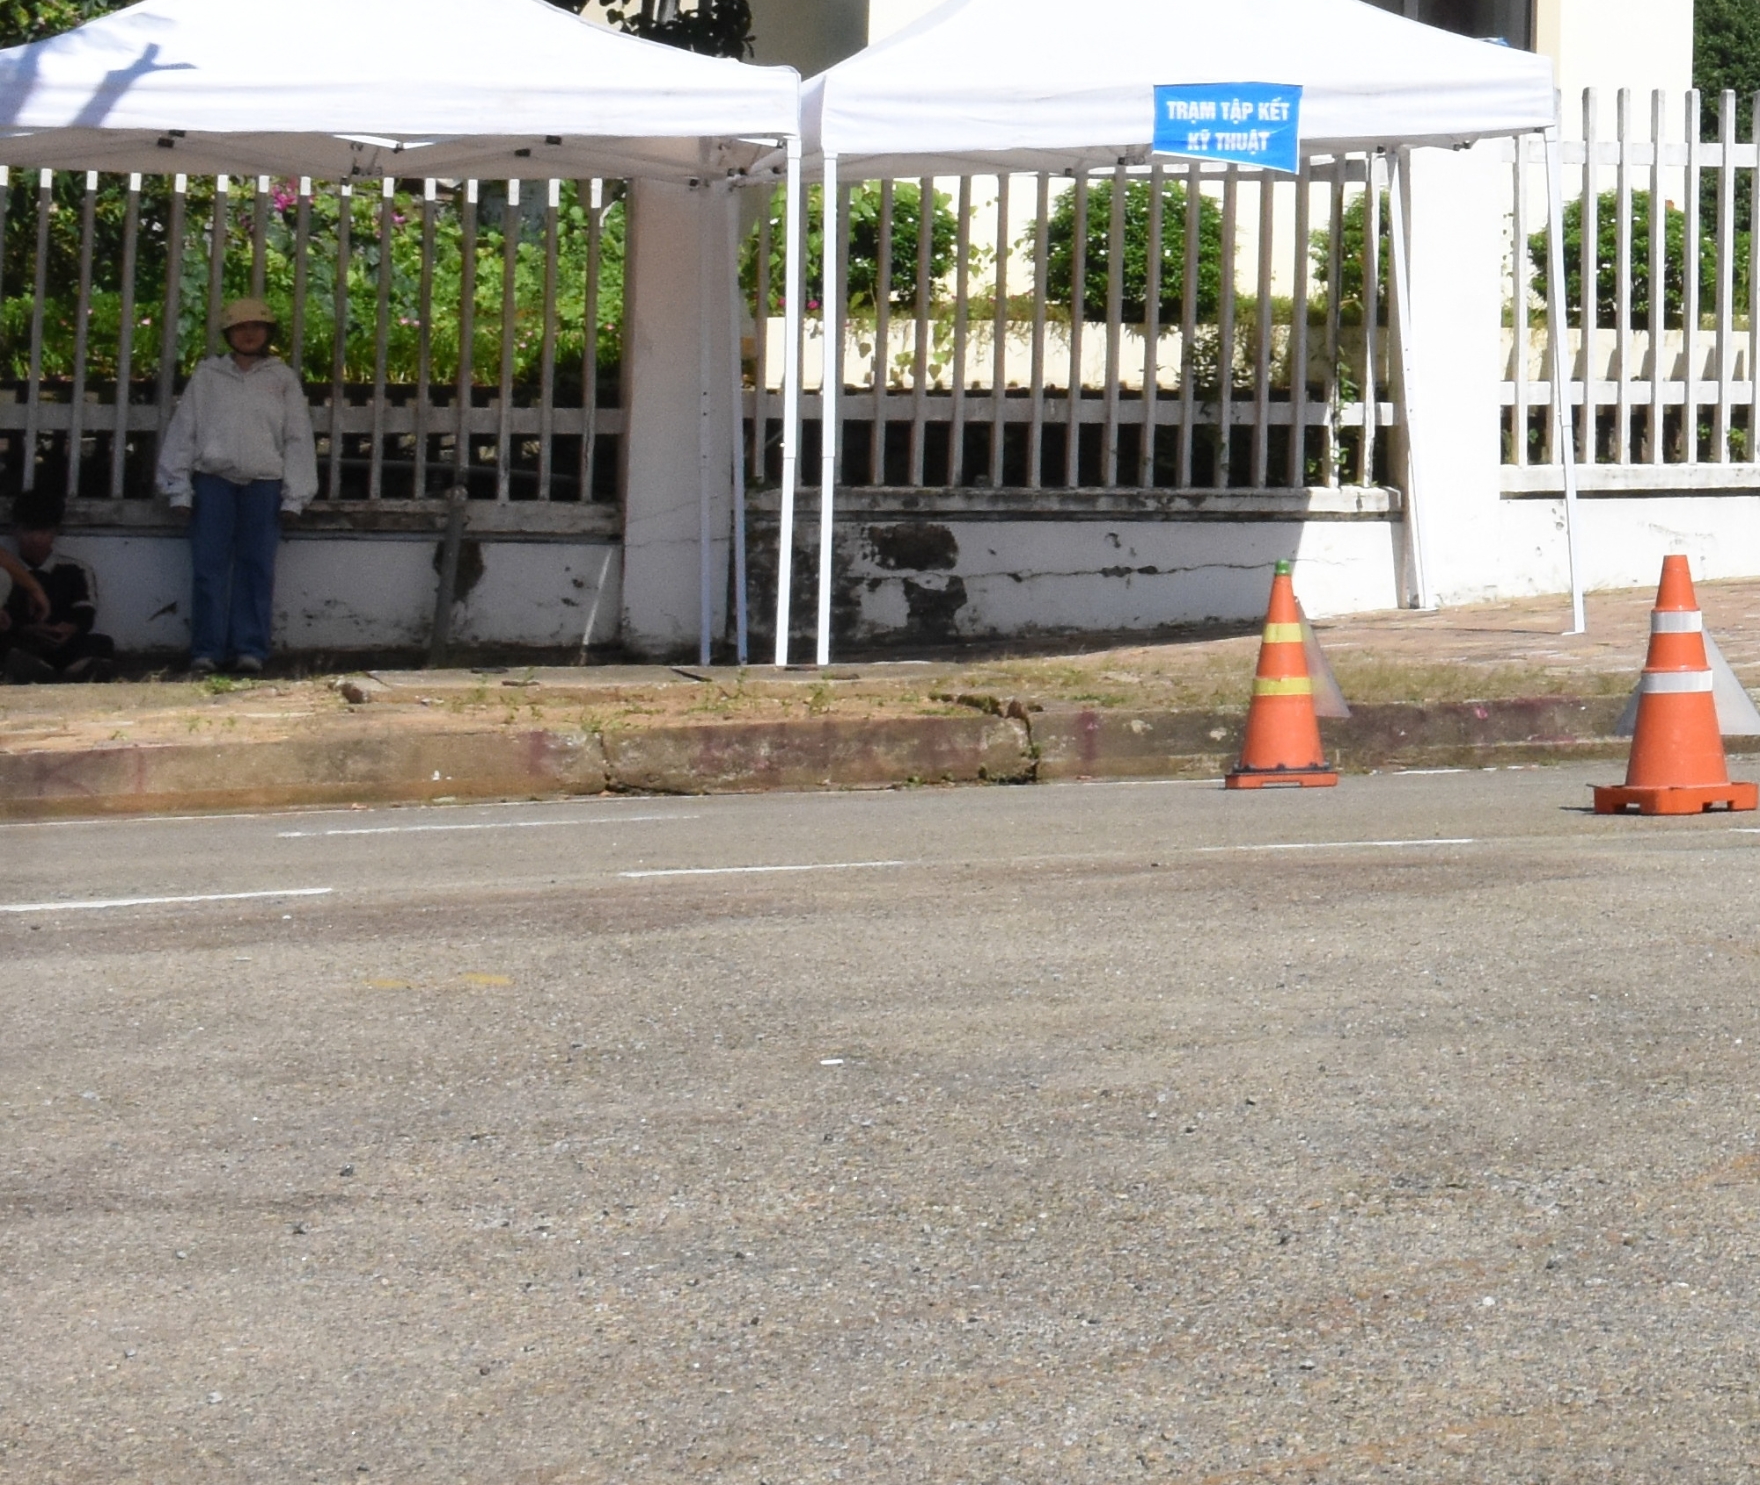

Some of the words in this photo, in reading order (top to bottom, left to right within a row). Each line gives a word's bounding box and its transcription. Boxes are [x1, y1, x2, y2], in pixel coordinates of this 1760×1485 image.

[1166, 100, 1216, 124] TRẠM
[1220, 98, 1254, 125] TẬP
[1258, 97, 1290, 121] KẾT
[1187, 129, 1211, 151] KỸ
[1215, 129, 1271, 155] THUẬT
